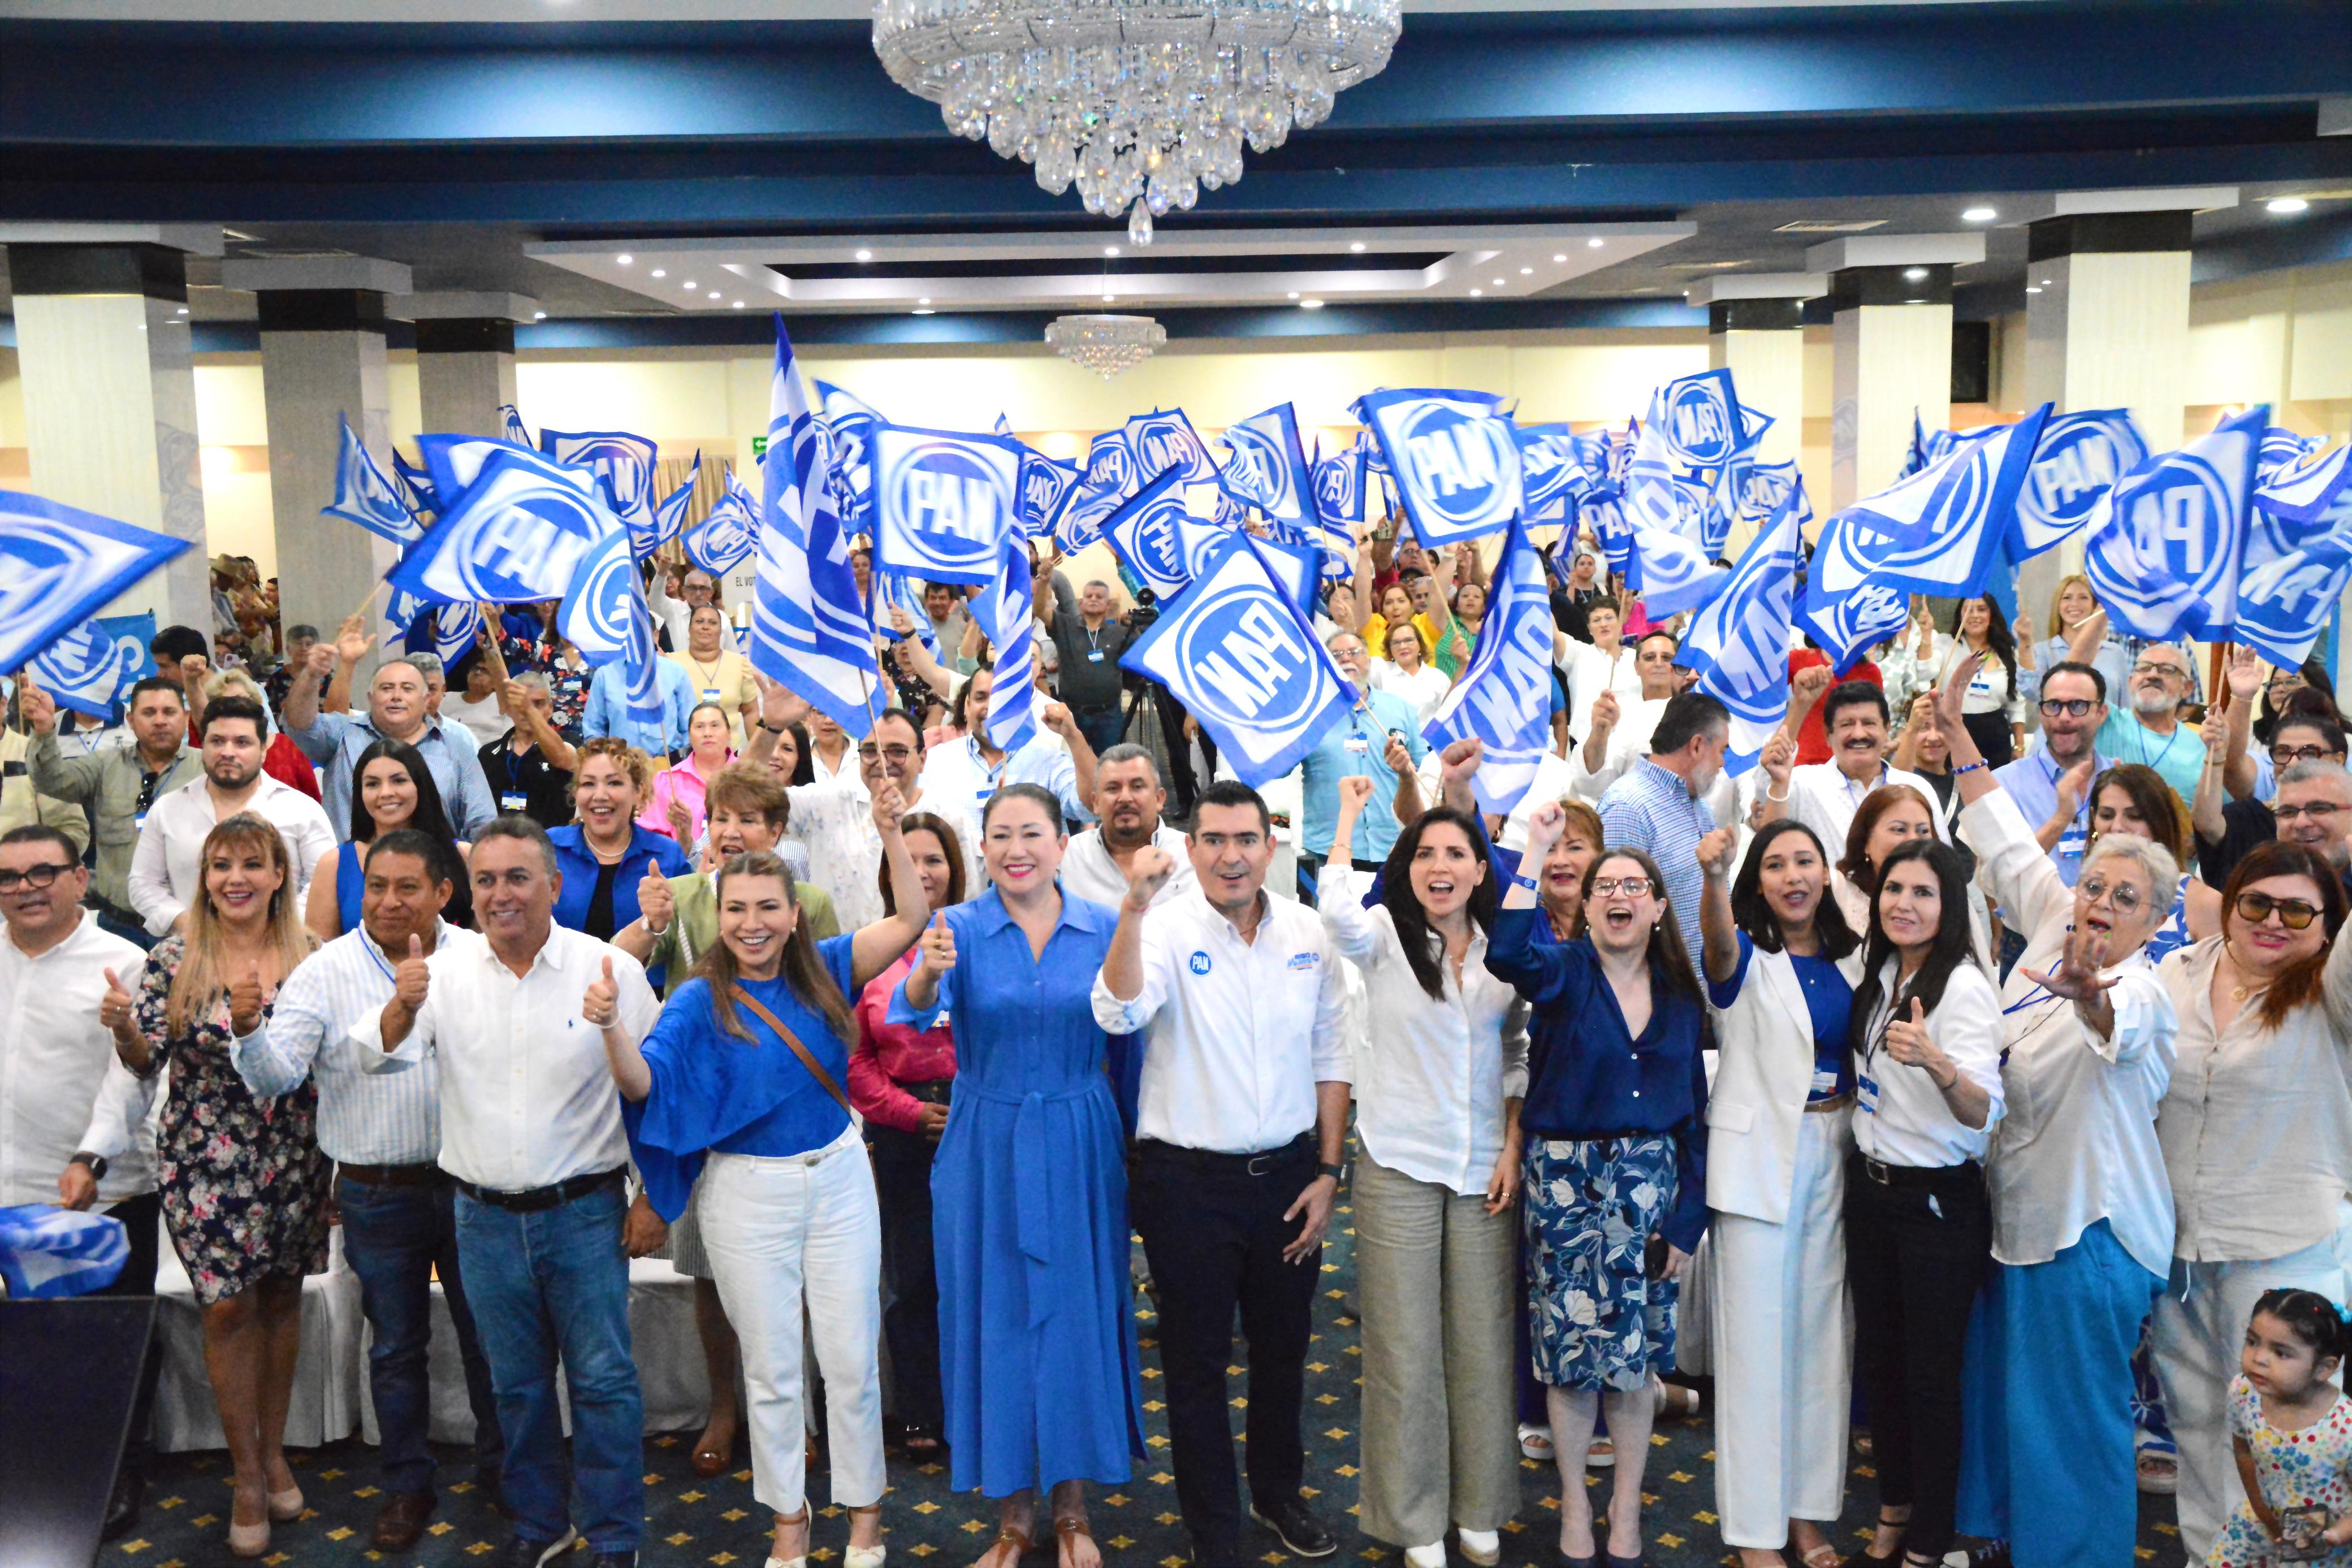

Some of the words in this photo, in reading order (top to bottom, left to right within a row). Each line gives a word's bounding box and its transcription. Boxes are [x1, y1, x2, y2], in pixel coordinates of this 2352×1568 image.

[1404, 419, 1499, 500] PAN
[2032, 435, 2115, 514] PAN
[906, 469, 997, 546] PAN
[472, 504, 591, 595] PAN
[736, 577, 743, 586] EL
[1192, 955, 1209, 971] PAN
